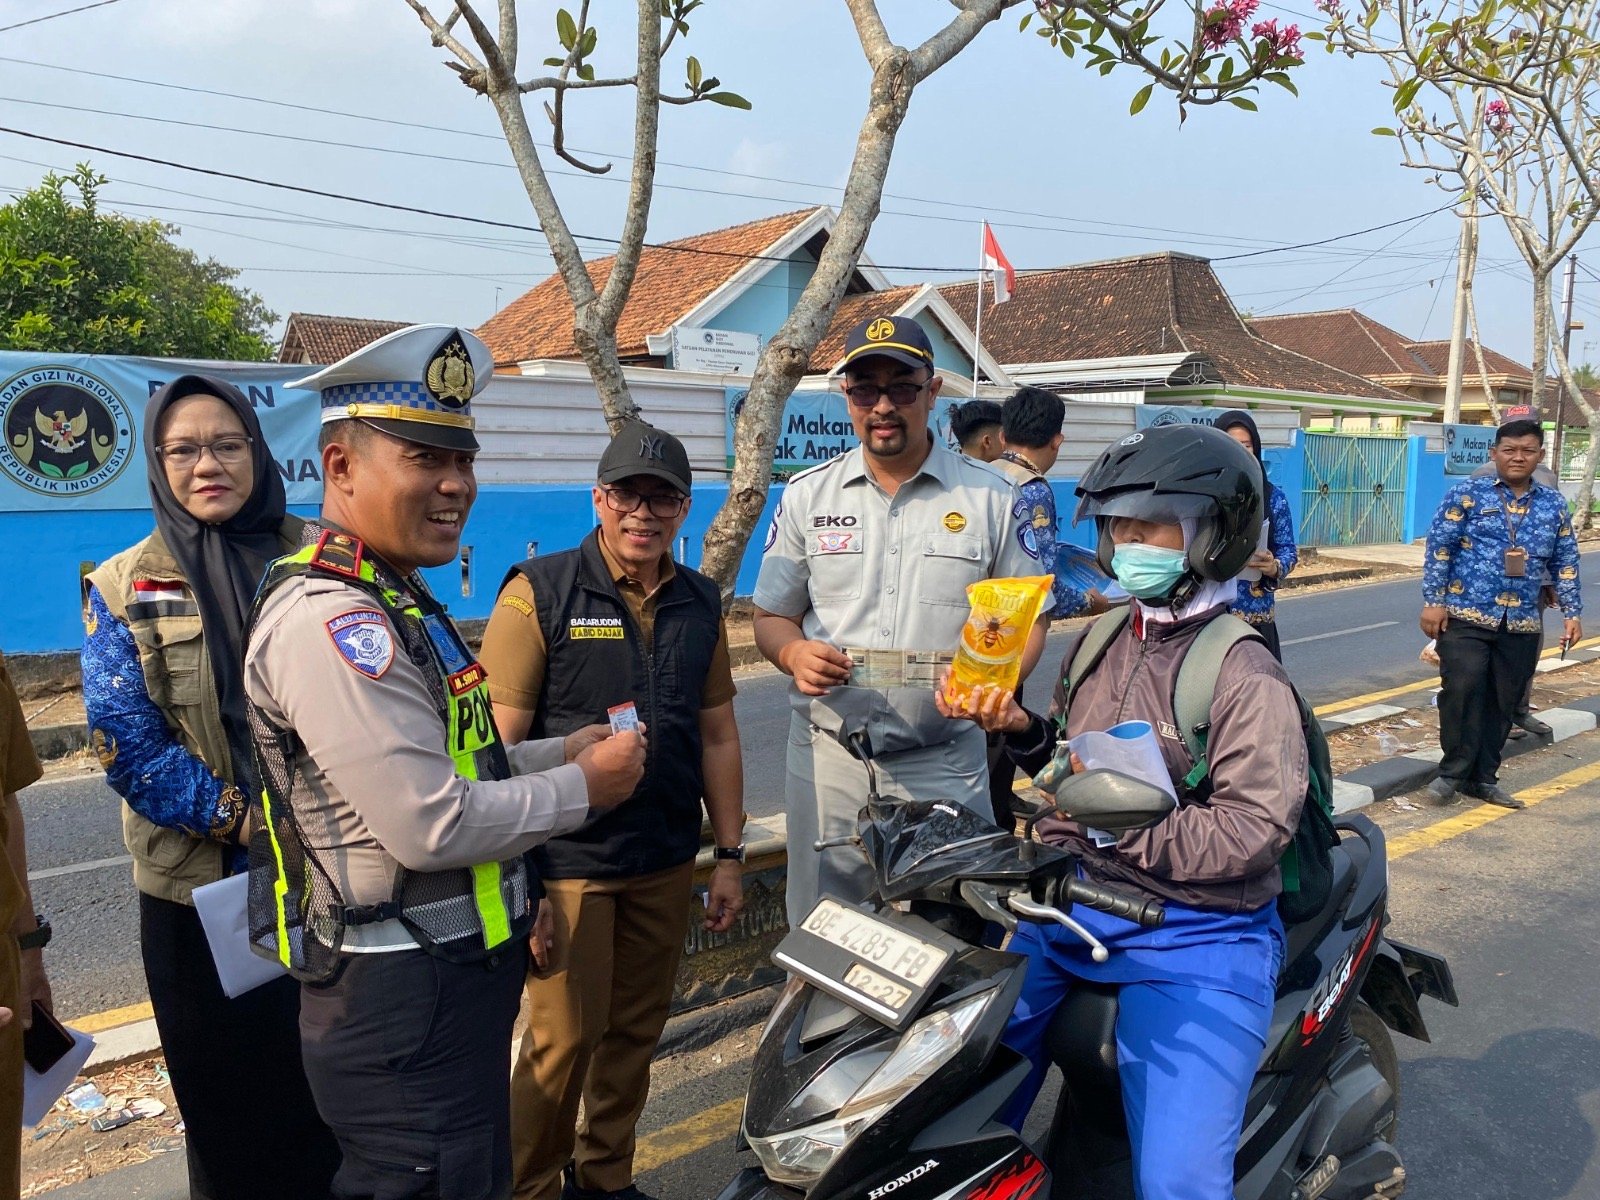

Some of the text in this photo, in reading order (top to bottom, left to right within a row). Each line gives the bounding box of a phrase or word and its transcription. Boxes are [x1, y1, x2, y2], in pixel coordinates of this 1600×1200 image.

[32, 371, 60, 382] GIZI
[66, 372, 123, 419] NASIONAL
[788, 413, 855, 436] Makan
[774, 437, 798, 460] ak
[1462, 437, 1486, 450] Makan
[0, 445, 126, 491] REPUBLIK INDONESIA
[1466, 451, 1485, 464] Anak
[813, 514, 857, 528] EKO
[571, 617, 621, 626] BADARUDDIN
[597, 629, 622, 637] PAJAK
[808, 908, 842, 937] BE
[892, 945, 930, 979] FB
[867, 1158, 940, 1200] HONDA
